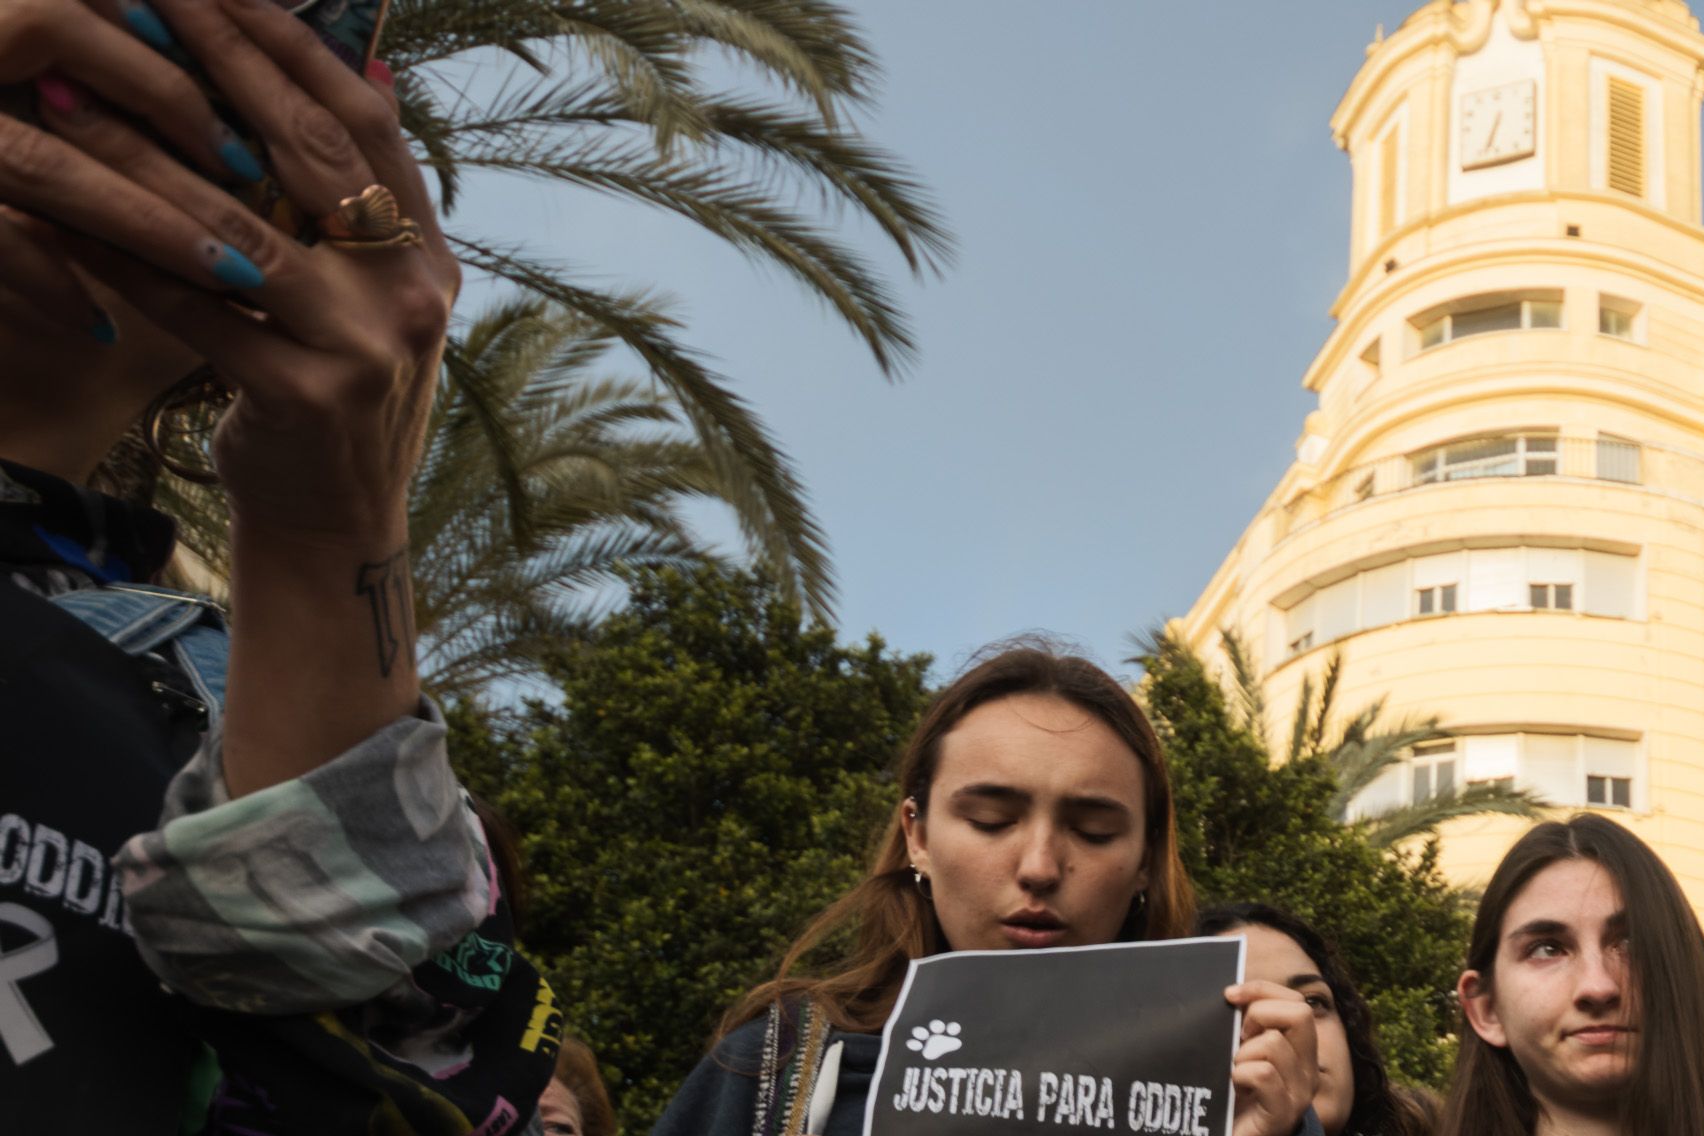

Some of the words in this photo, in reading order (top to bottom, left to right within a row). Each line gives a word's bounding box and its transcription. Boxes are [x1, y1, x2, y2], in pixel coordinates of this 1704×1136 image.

[0, 813, 136, 936] ODDI
[893, 1067, 1024, 1120] JUSTICIA
[1037, 1071, 1115, 1129] PARA
